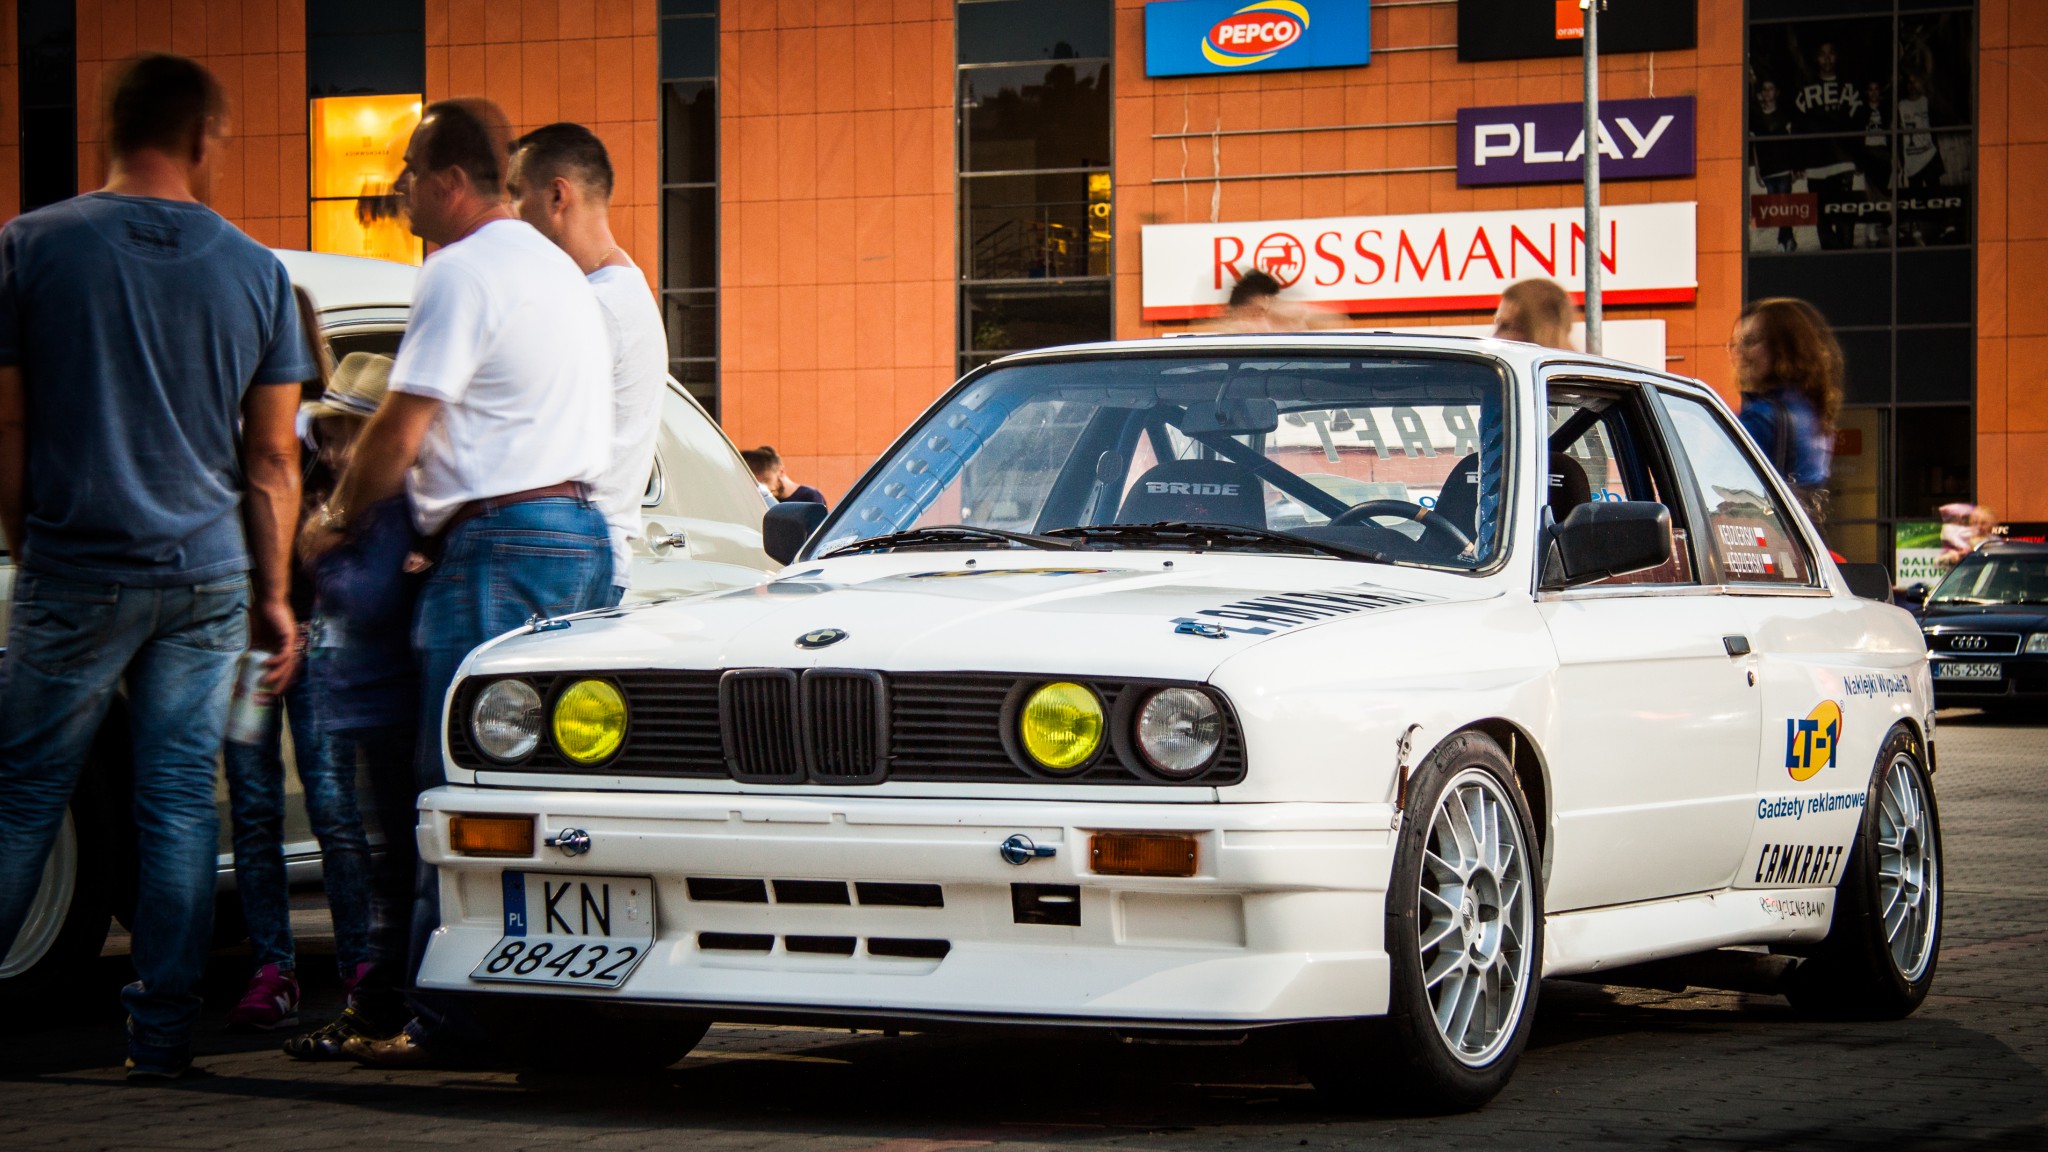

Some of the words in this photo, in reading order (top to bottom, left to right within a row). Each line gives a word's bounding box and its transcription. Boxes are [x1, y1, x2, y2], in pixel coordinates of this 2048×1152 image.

[1218, 21, 1295, 46] PEPCO
[1558, 28, 1584, 38] orang
[1474, 115, 1674, 166] PLAY
[1759, 202, 1810, 220] young
[1213, 220, 1617, 290] ROSSMANN
[1146, 482, 1240, 496] BRIDE
[1991, 526, 2009, 535] KFC
[1939, 663, 1961, 676] KNS
[1966, 663, 1999, 676] 25562
[1843, 674, 1878, 699] Naklejki
[1785, 718, 1837, 769] LT-1
[1758, 795, 1804, 821] Gadżety
[1807, 789, 1865, 815] reklamowe
[1755, 844, 1843, 884] CAMKRAFT
[509, 912, 524, 927] PL
[544, 881, 611, 936] KN
[486, 941, 638, 981] 88432
